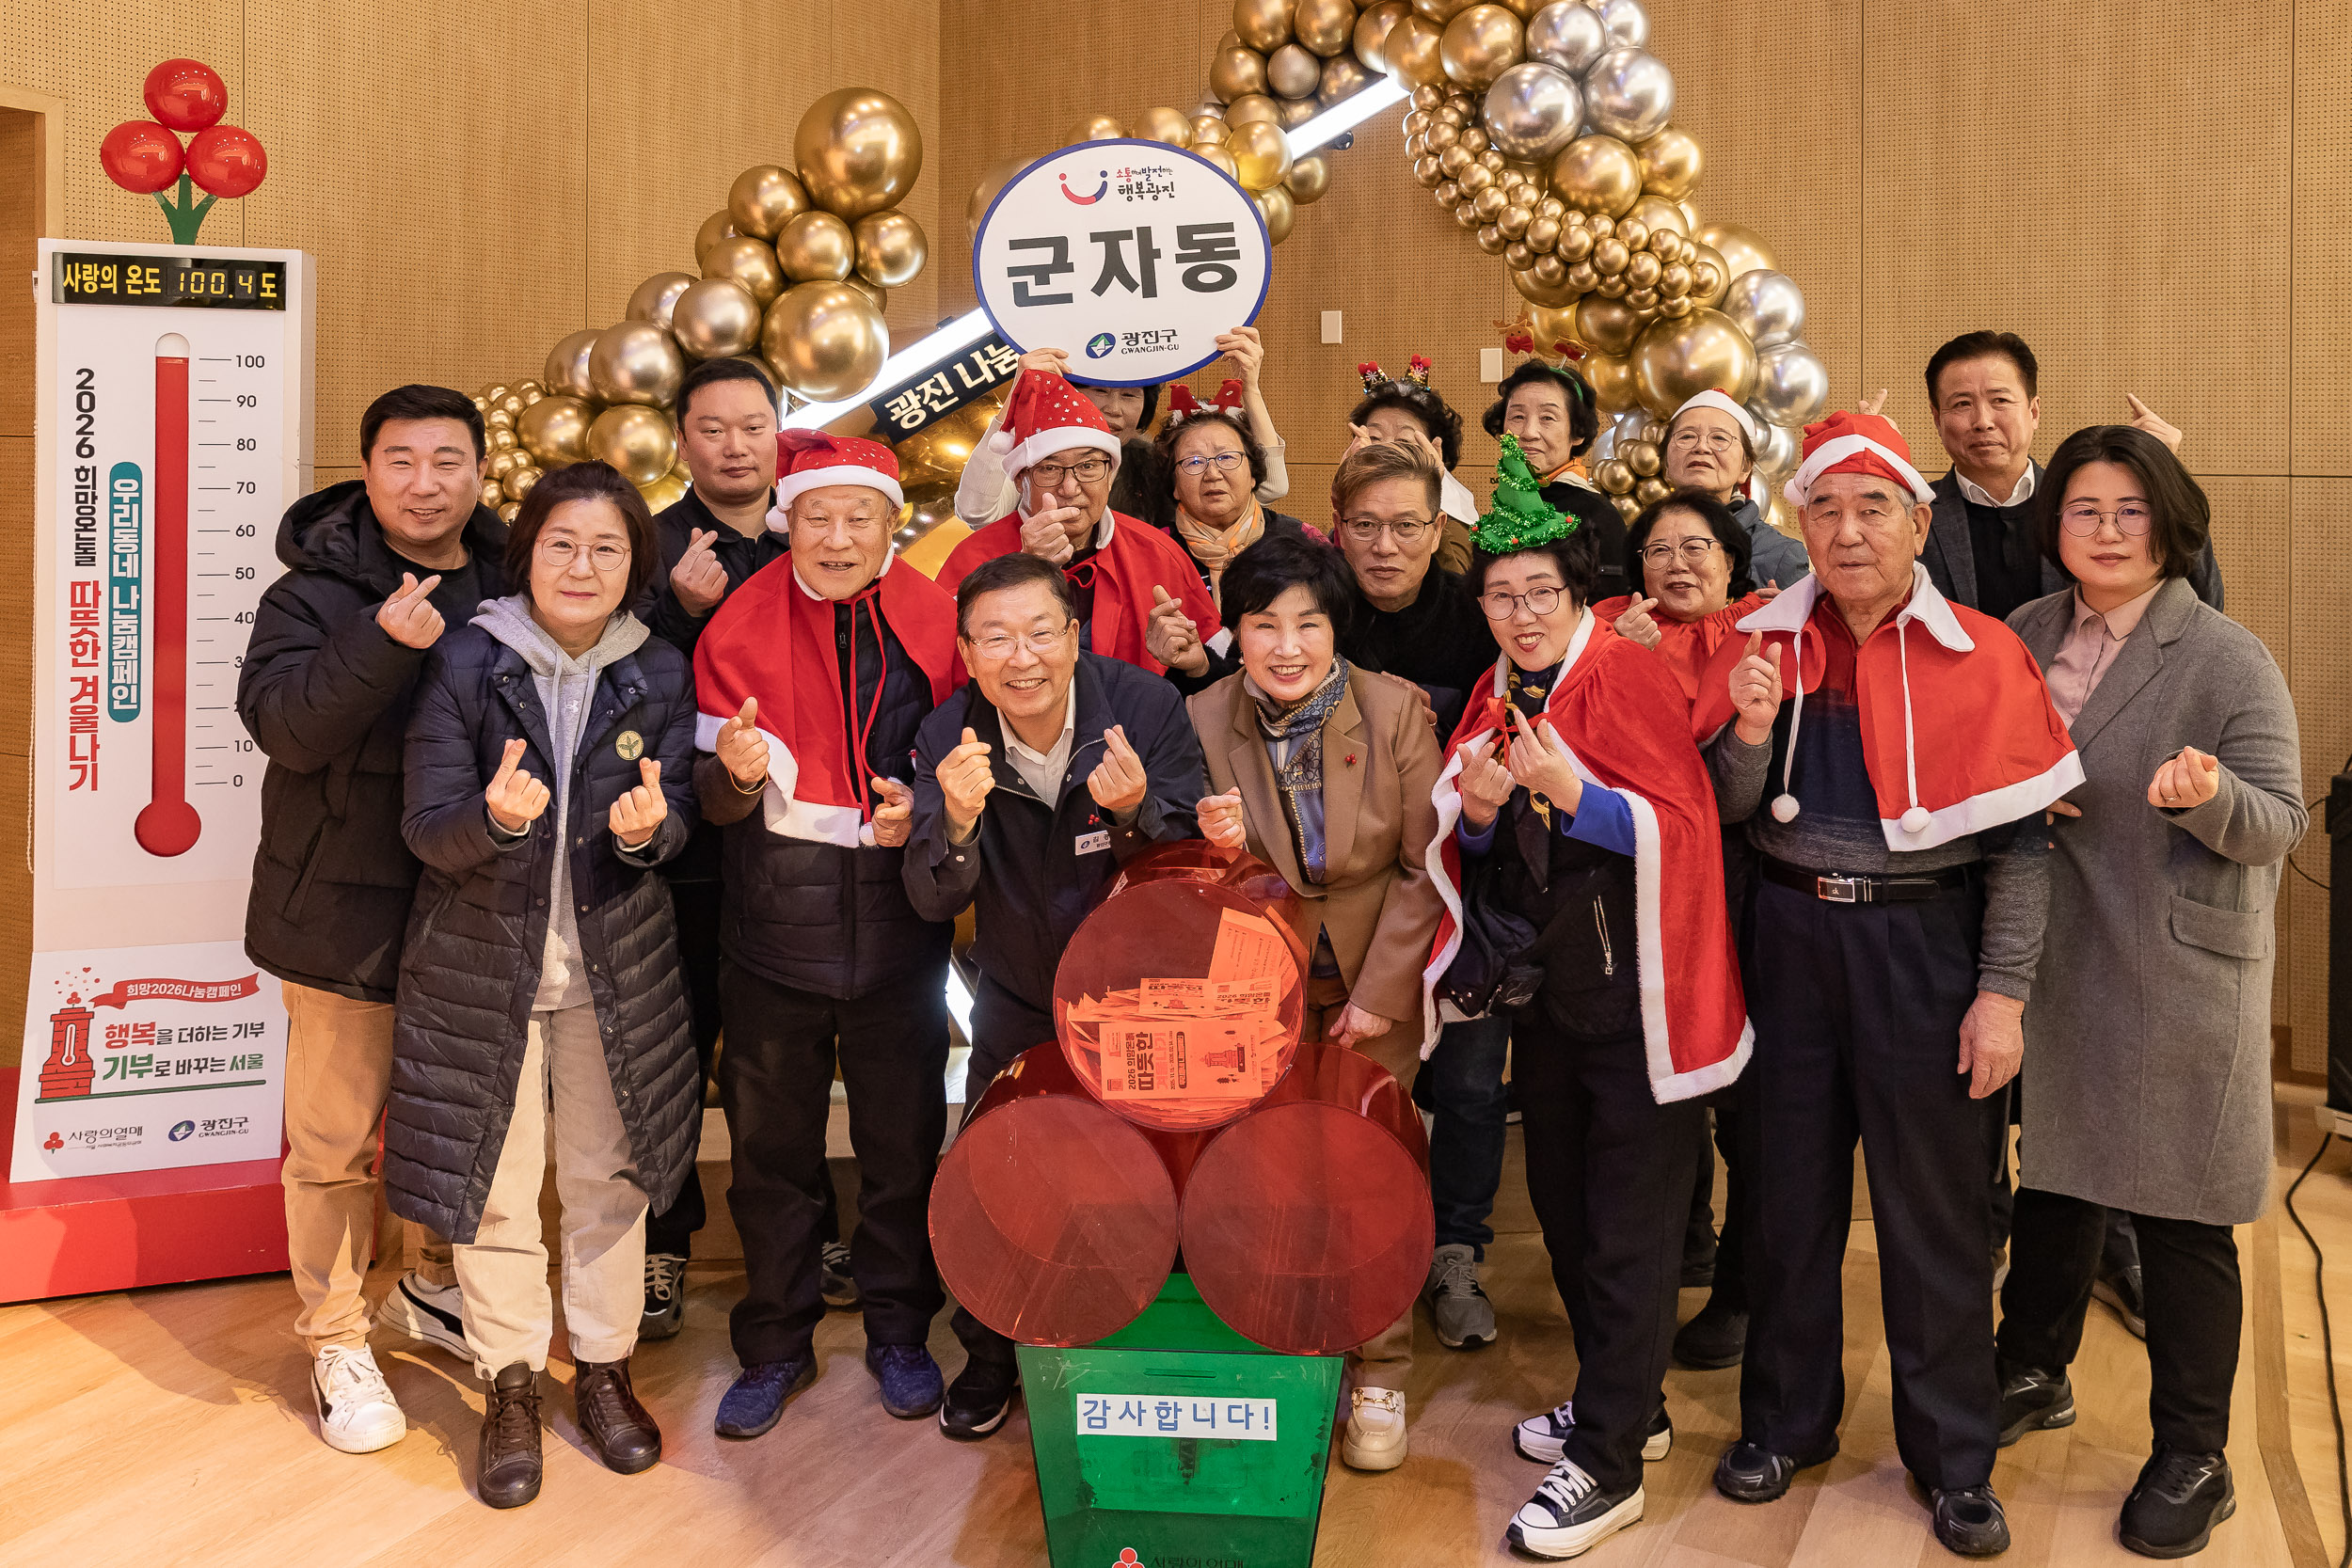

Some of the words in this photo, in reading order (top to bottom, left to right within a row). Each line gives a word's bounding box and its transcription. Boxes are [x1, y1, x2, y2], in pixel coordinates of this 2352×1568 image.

[1117, 181, 1175, 202] 행복광진
[1007, 221, 1241, 308] 군자동
[63, 262, 118, 294] 사랑의
[125, 264, 162, 294] 온도
[260, 273, 278, 298] 도
[1120, 328, 1178, 346] 광진구
[1120, 344, 1180, 355] GWANGJIN-GU
[235, 355, 265, 369] 100
[236, 395, 257, 408] 90
[884, 372, 960, 430] 광진
[75, 368, 96, 459] 2026
[235, 438, 257, 451] 80
[235, 482, 256, 495] 70
[74, 465, 99, 567] 희망온돌
[112, 478, 140, 578] 우리동네
[235, 525, 256, 537] 60
[234, 567, 255, 579] 50
[69, 579, 102, 668] 따뜻한
[234, 611, 255, 625] 40
[111, 585, 140, 710] 나눔캠페인
[69, 675, 101, 792] 겨울나기
[234, 740, 253, 752] 10
[232, 774, 244, 787] 0
[126, 983, 242, 999] 희망2026나눔캠페인
[104, 1022, 173, 1049] 행복을
[177, 1025, 228, 1044] 더하는
[231, 1022, 265, 1039] 기부
[103, 1053, 171, 1081] 기부로
[175, 1056, 226, 1076] 바꾸는
[229, 1053, 264, 1071] 서울
[1136, 1032, 1154, 1091] 따뜻한
[1128, 1069, 1136, 1090] 2026
[199, 1117, 249, 1131] 광진구
[68, 1125, 143, 1145] 사랑의열매
[1082, 1399, 1270, 1432] 감사합니다!
